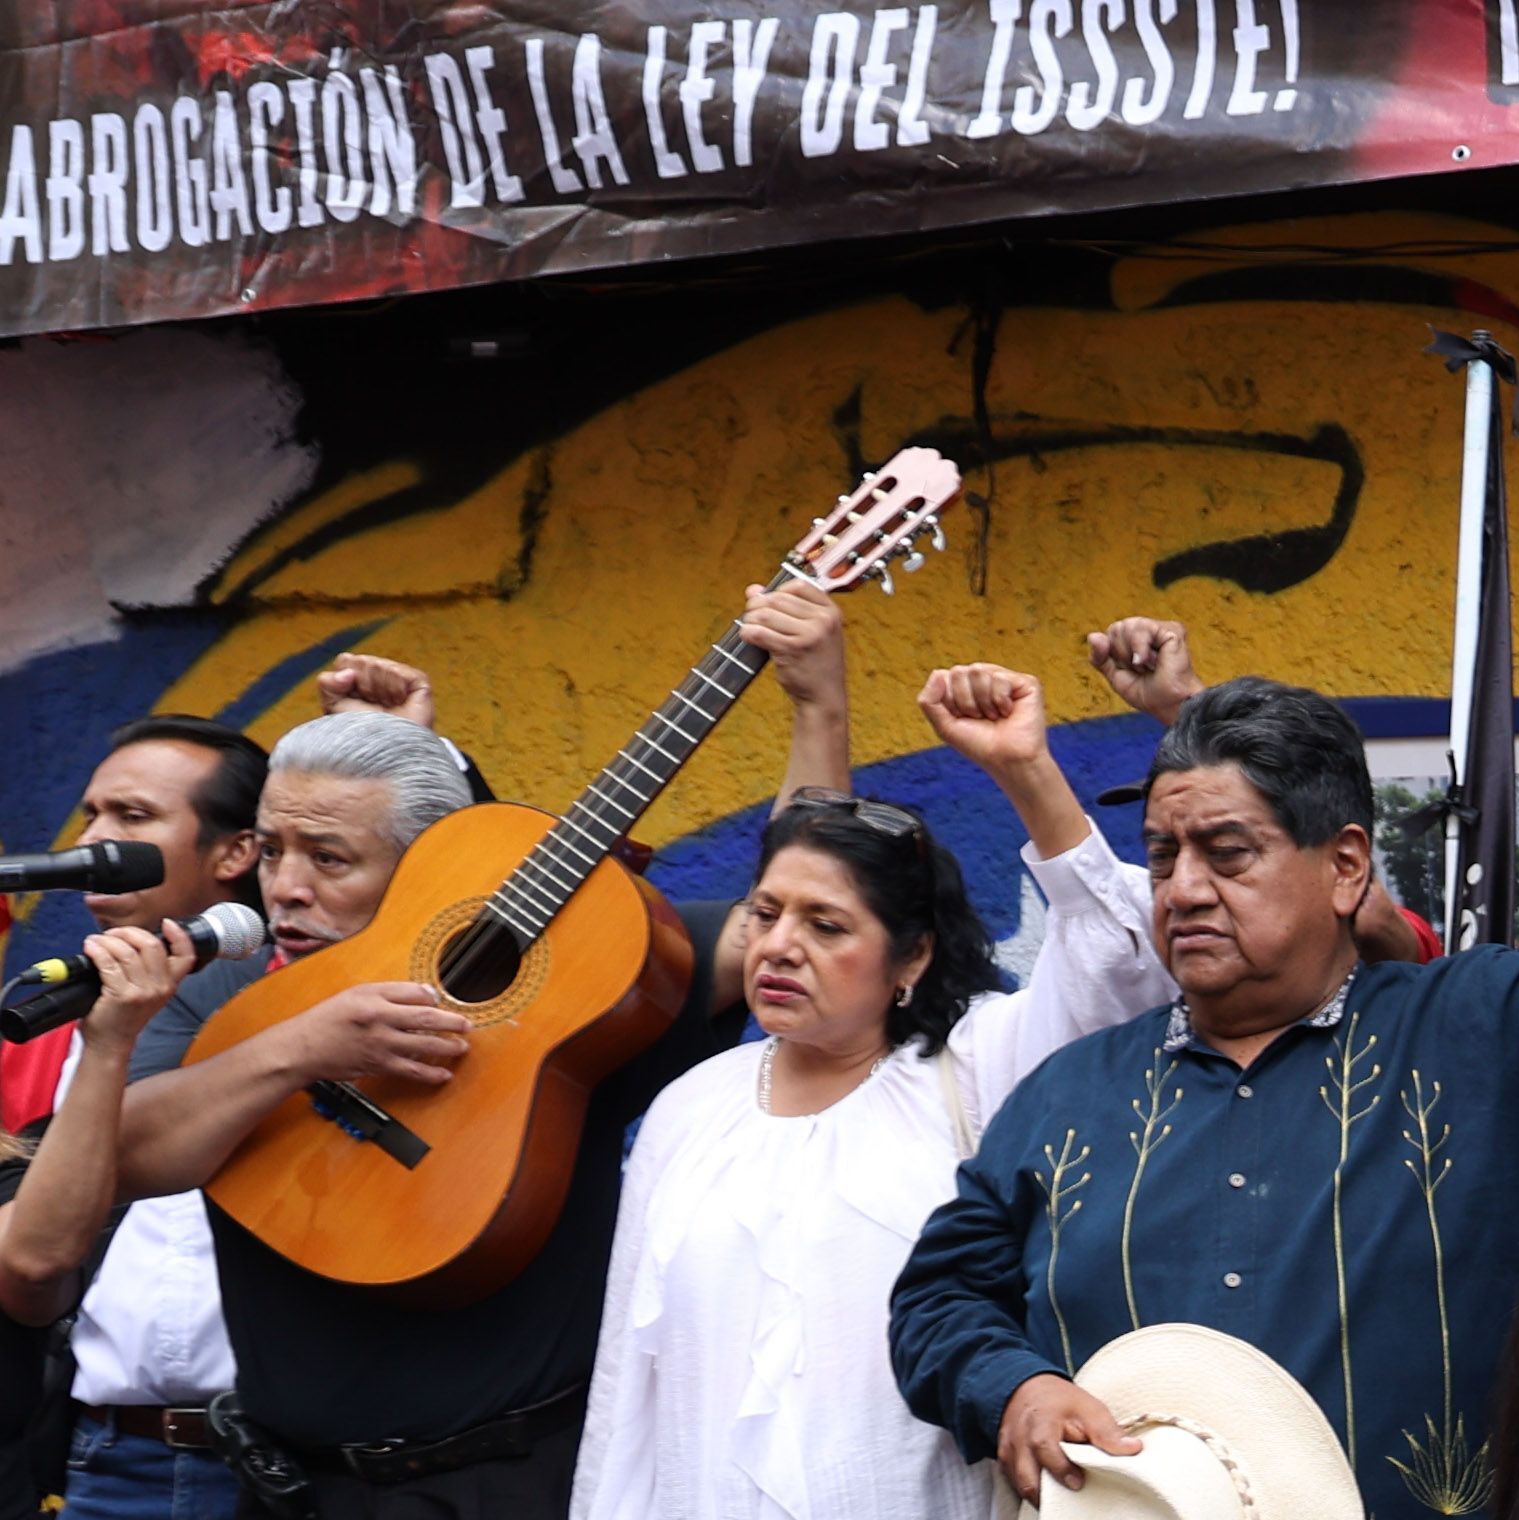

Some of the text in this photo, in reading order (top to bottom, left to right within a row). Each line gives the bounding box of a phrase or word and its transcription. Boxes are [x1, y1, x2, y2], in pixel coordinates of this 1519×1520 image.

[0, 0, 1299, 264] ABROGACIÓN DE LA LEY DEL ISSSTE!
